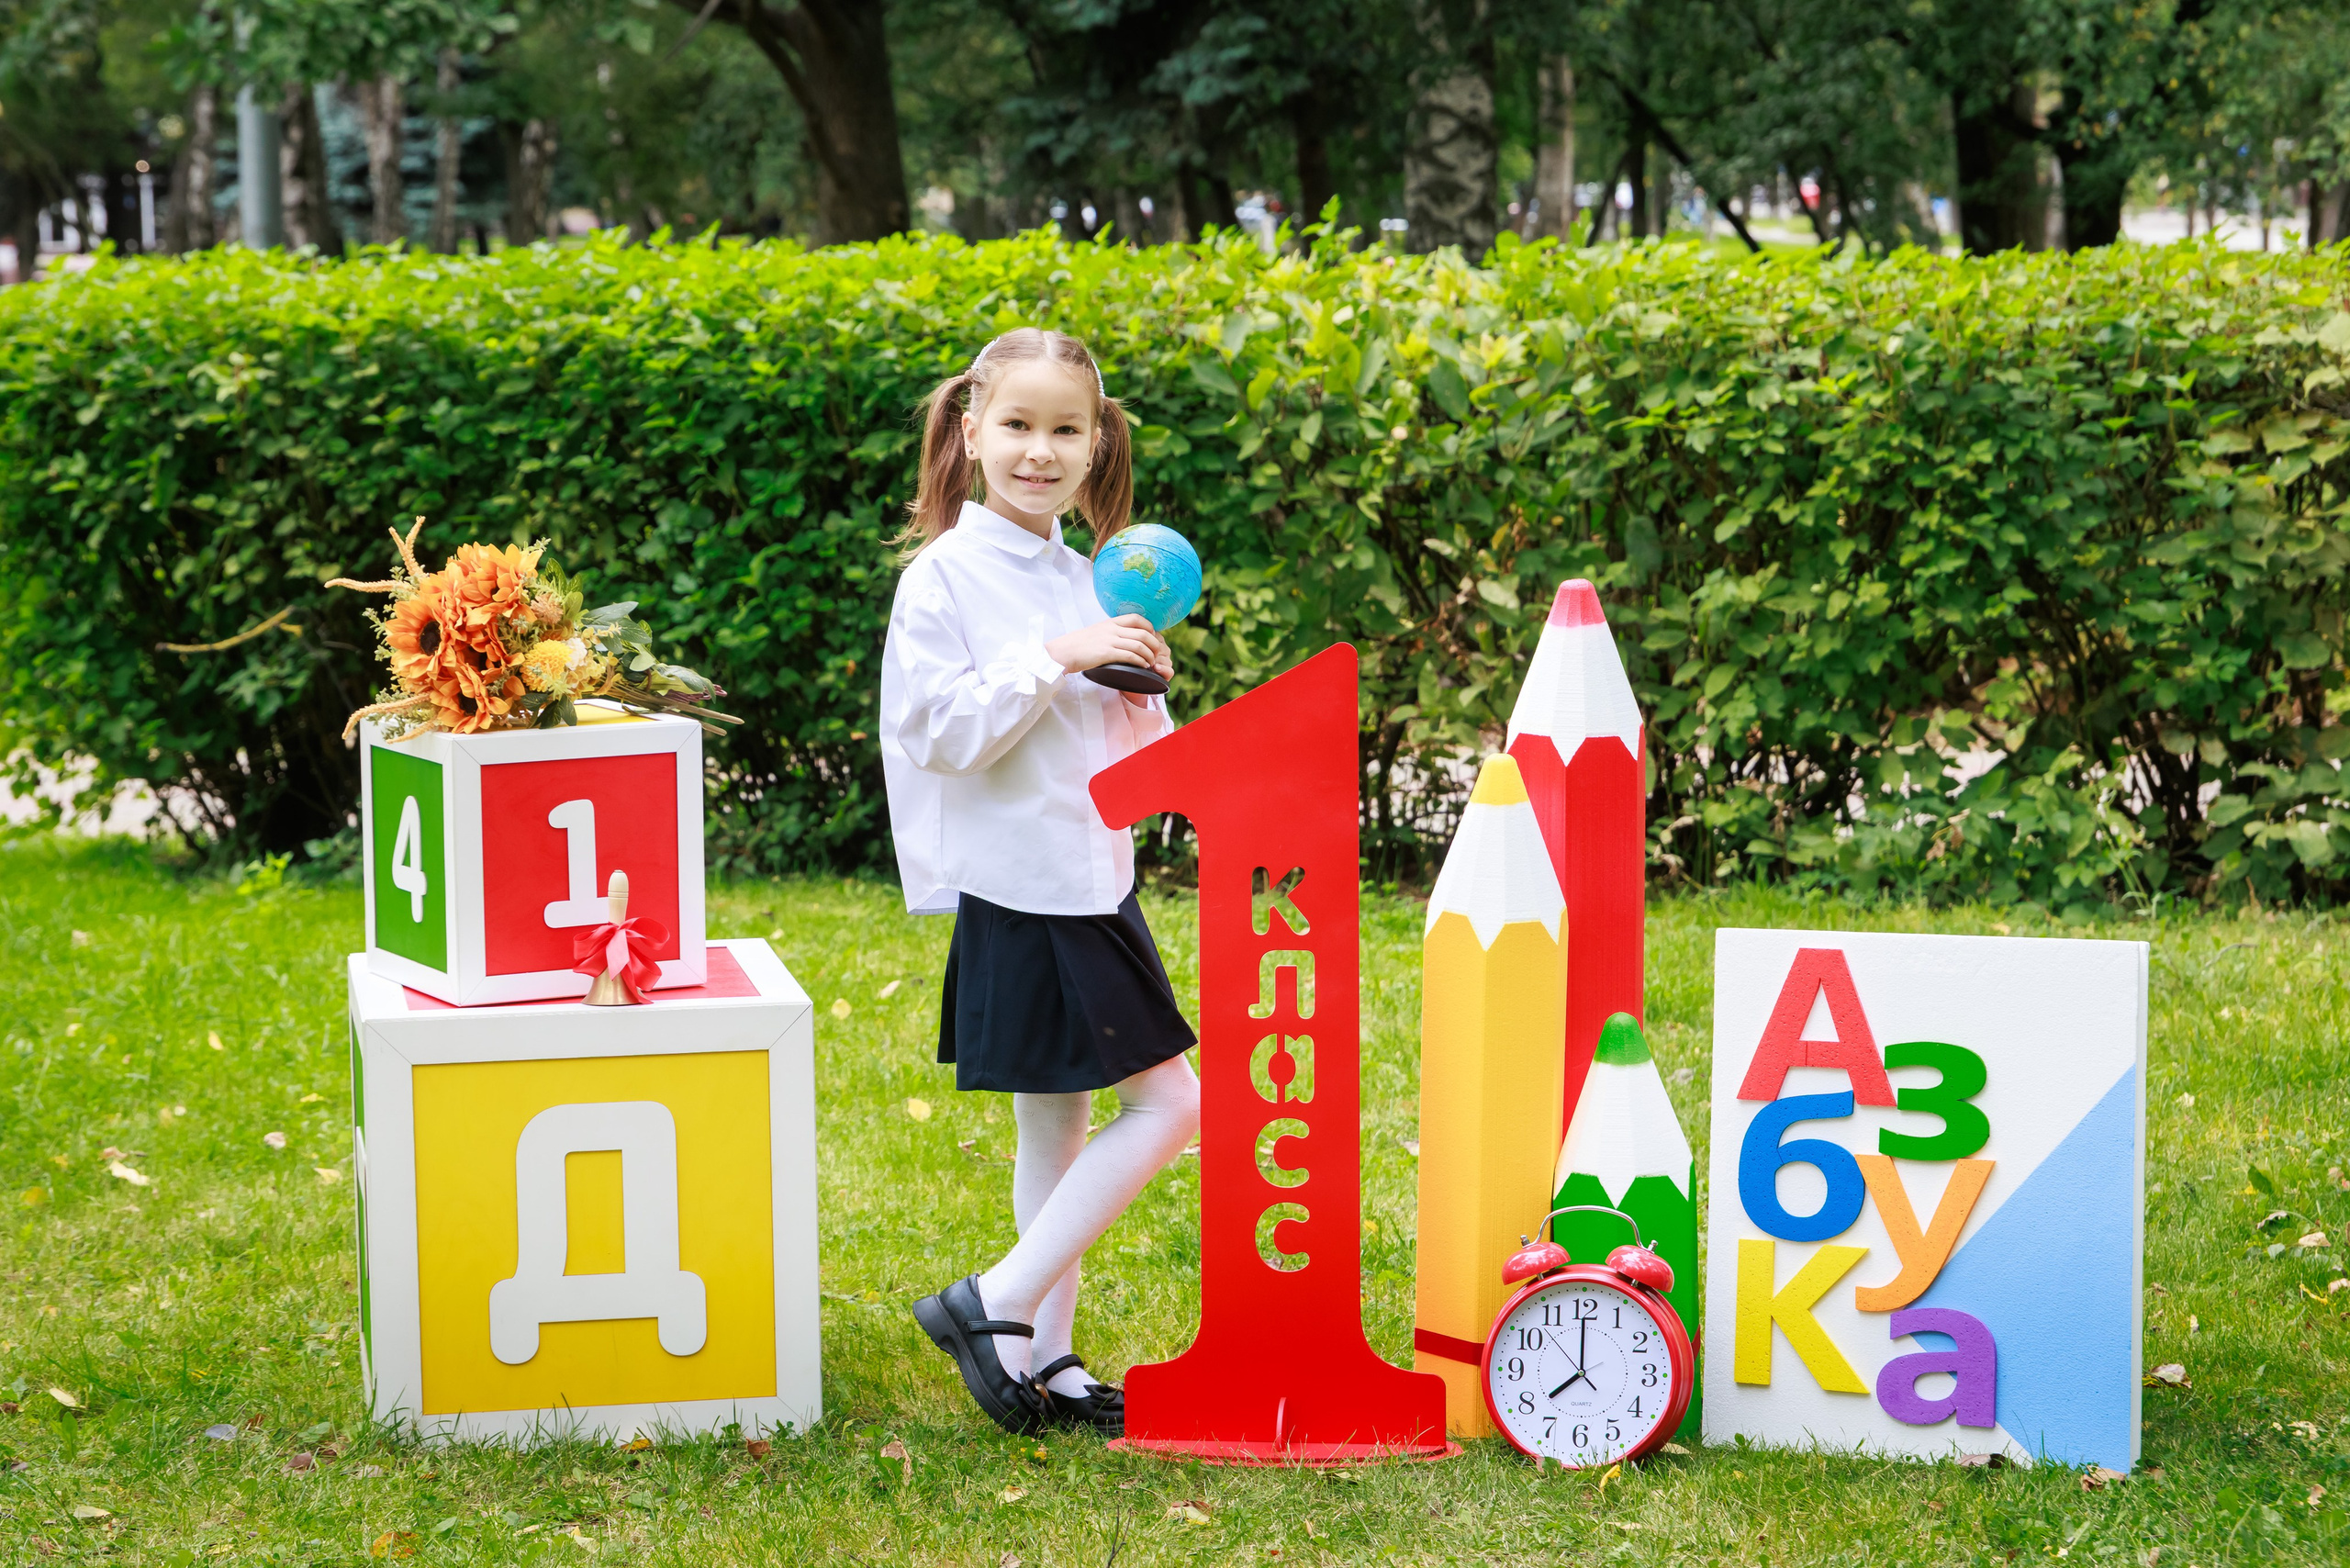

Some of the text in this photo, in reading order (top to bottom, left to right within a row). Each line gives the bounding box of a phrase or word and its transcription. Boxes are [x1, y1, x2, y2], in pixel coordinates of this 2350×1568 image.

[391, 795, 428, 924] 4
[543, 799, 611, 928] 1
[488, 1101, 708, 1366] Д
[1541, 1304, 1563, 1327] 11
[1572, 1298, 1598, 1321] 12
[1612, 1306, 1623, 1328] 1
[1516, 1327, 1543, 1351] 10
[1632, 1331, 1649, 1353] 2
[1507, 1357, 1525, 1382] 9
[1641, 1363, 1658, 1387] 3
[1517, 1391, 1535, 1415] 8
[1627, 1395, 1643, 1417] 4
[1542, 1417, 1558, 1439] 7
[1572, 1424, 1589, 1448] 6
[1605, 1418, 1620, 1441] 5
